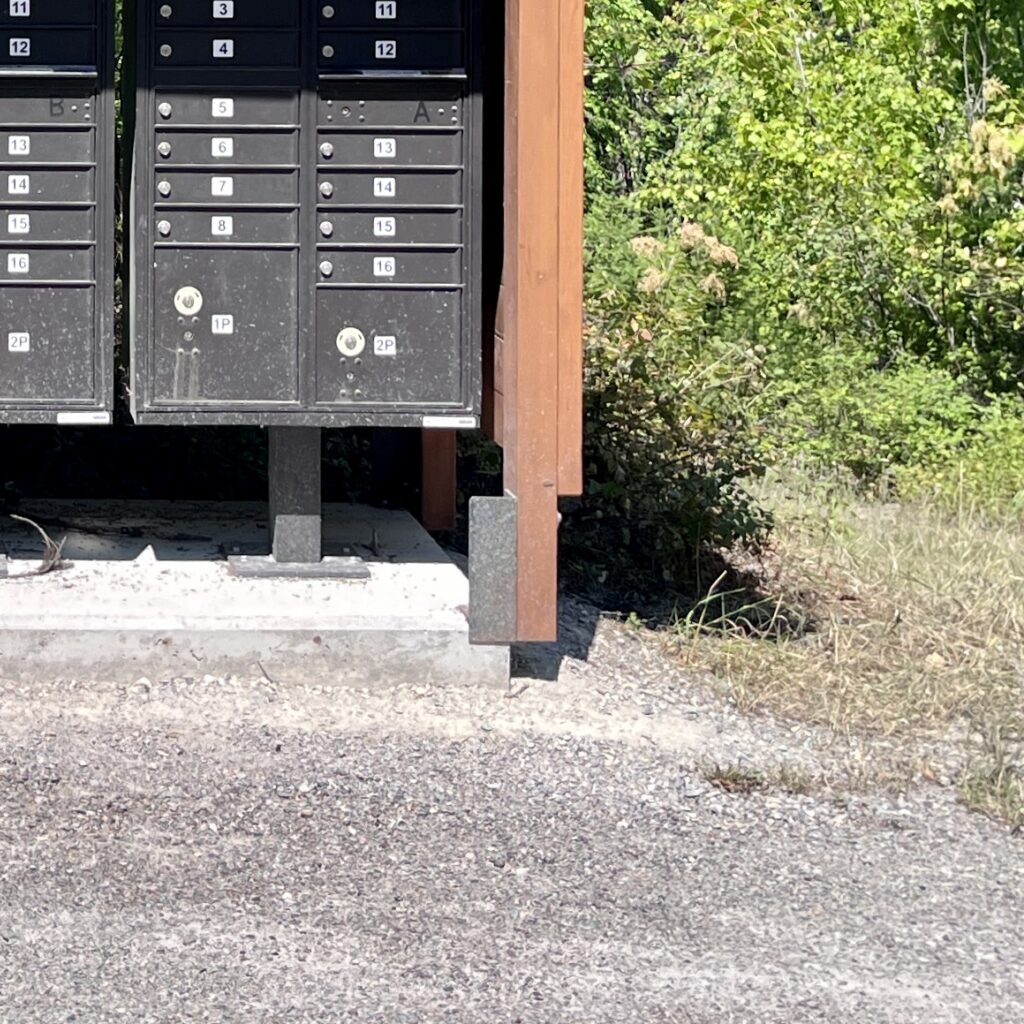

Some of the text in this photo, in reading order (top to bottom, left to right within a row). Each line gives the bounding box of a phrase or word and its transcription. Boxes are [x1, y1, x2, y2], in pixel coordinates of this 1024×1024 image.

[12, 1, 27, 14] 11
[219, 3, 228, 16] 3
[378, 3, 393, 17] 11
[11, 41, 28, 54] 12
[218, 42, 228, 55] 4
[377, 43, 394, 56] 12
[49, 95, 65, 117] B
[218, 101, 227, 114] 5
[413, 101, 431, 123] A
[11, 139, 27, 151] 13
[218, 141, 227, 154] 6
[377, 141, 393, 154] 13
[12, 178, 27, 190] 14
[219, 180, 227, 192] 7
[377, 180, 392, 193] 14
[11, 217, 28, 230] 15
[217, 219, 226, 232] 8
[377, 220, 393, 233] 15
[11, 256, 27, 269] 16
[375, 260, 392, 273] 16
[214, 318, 231, 330] 1P
[10, 336, 28, 348] 2P
[375, 339, 394, 352] 2P
